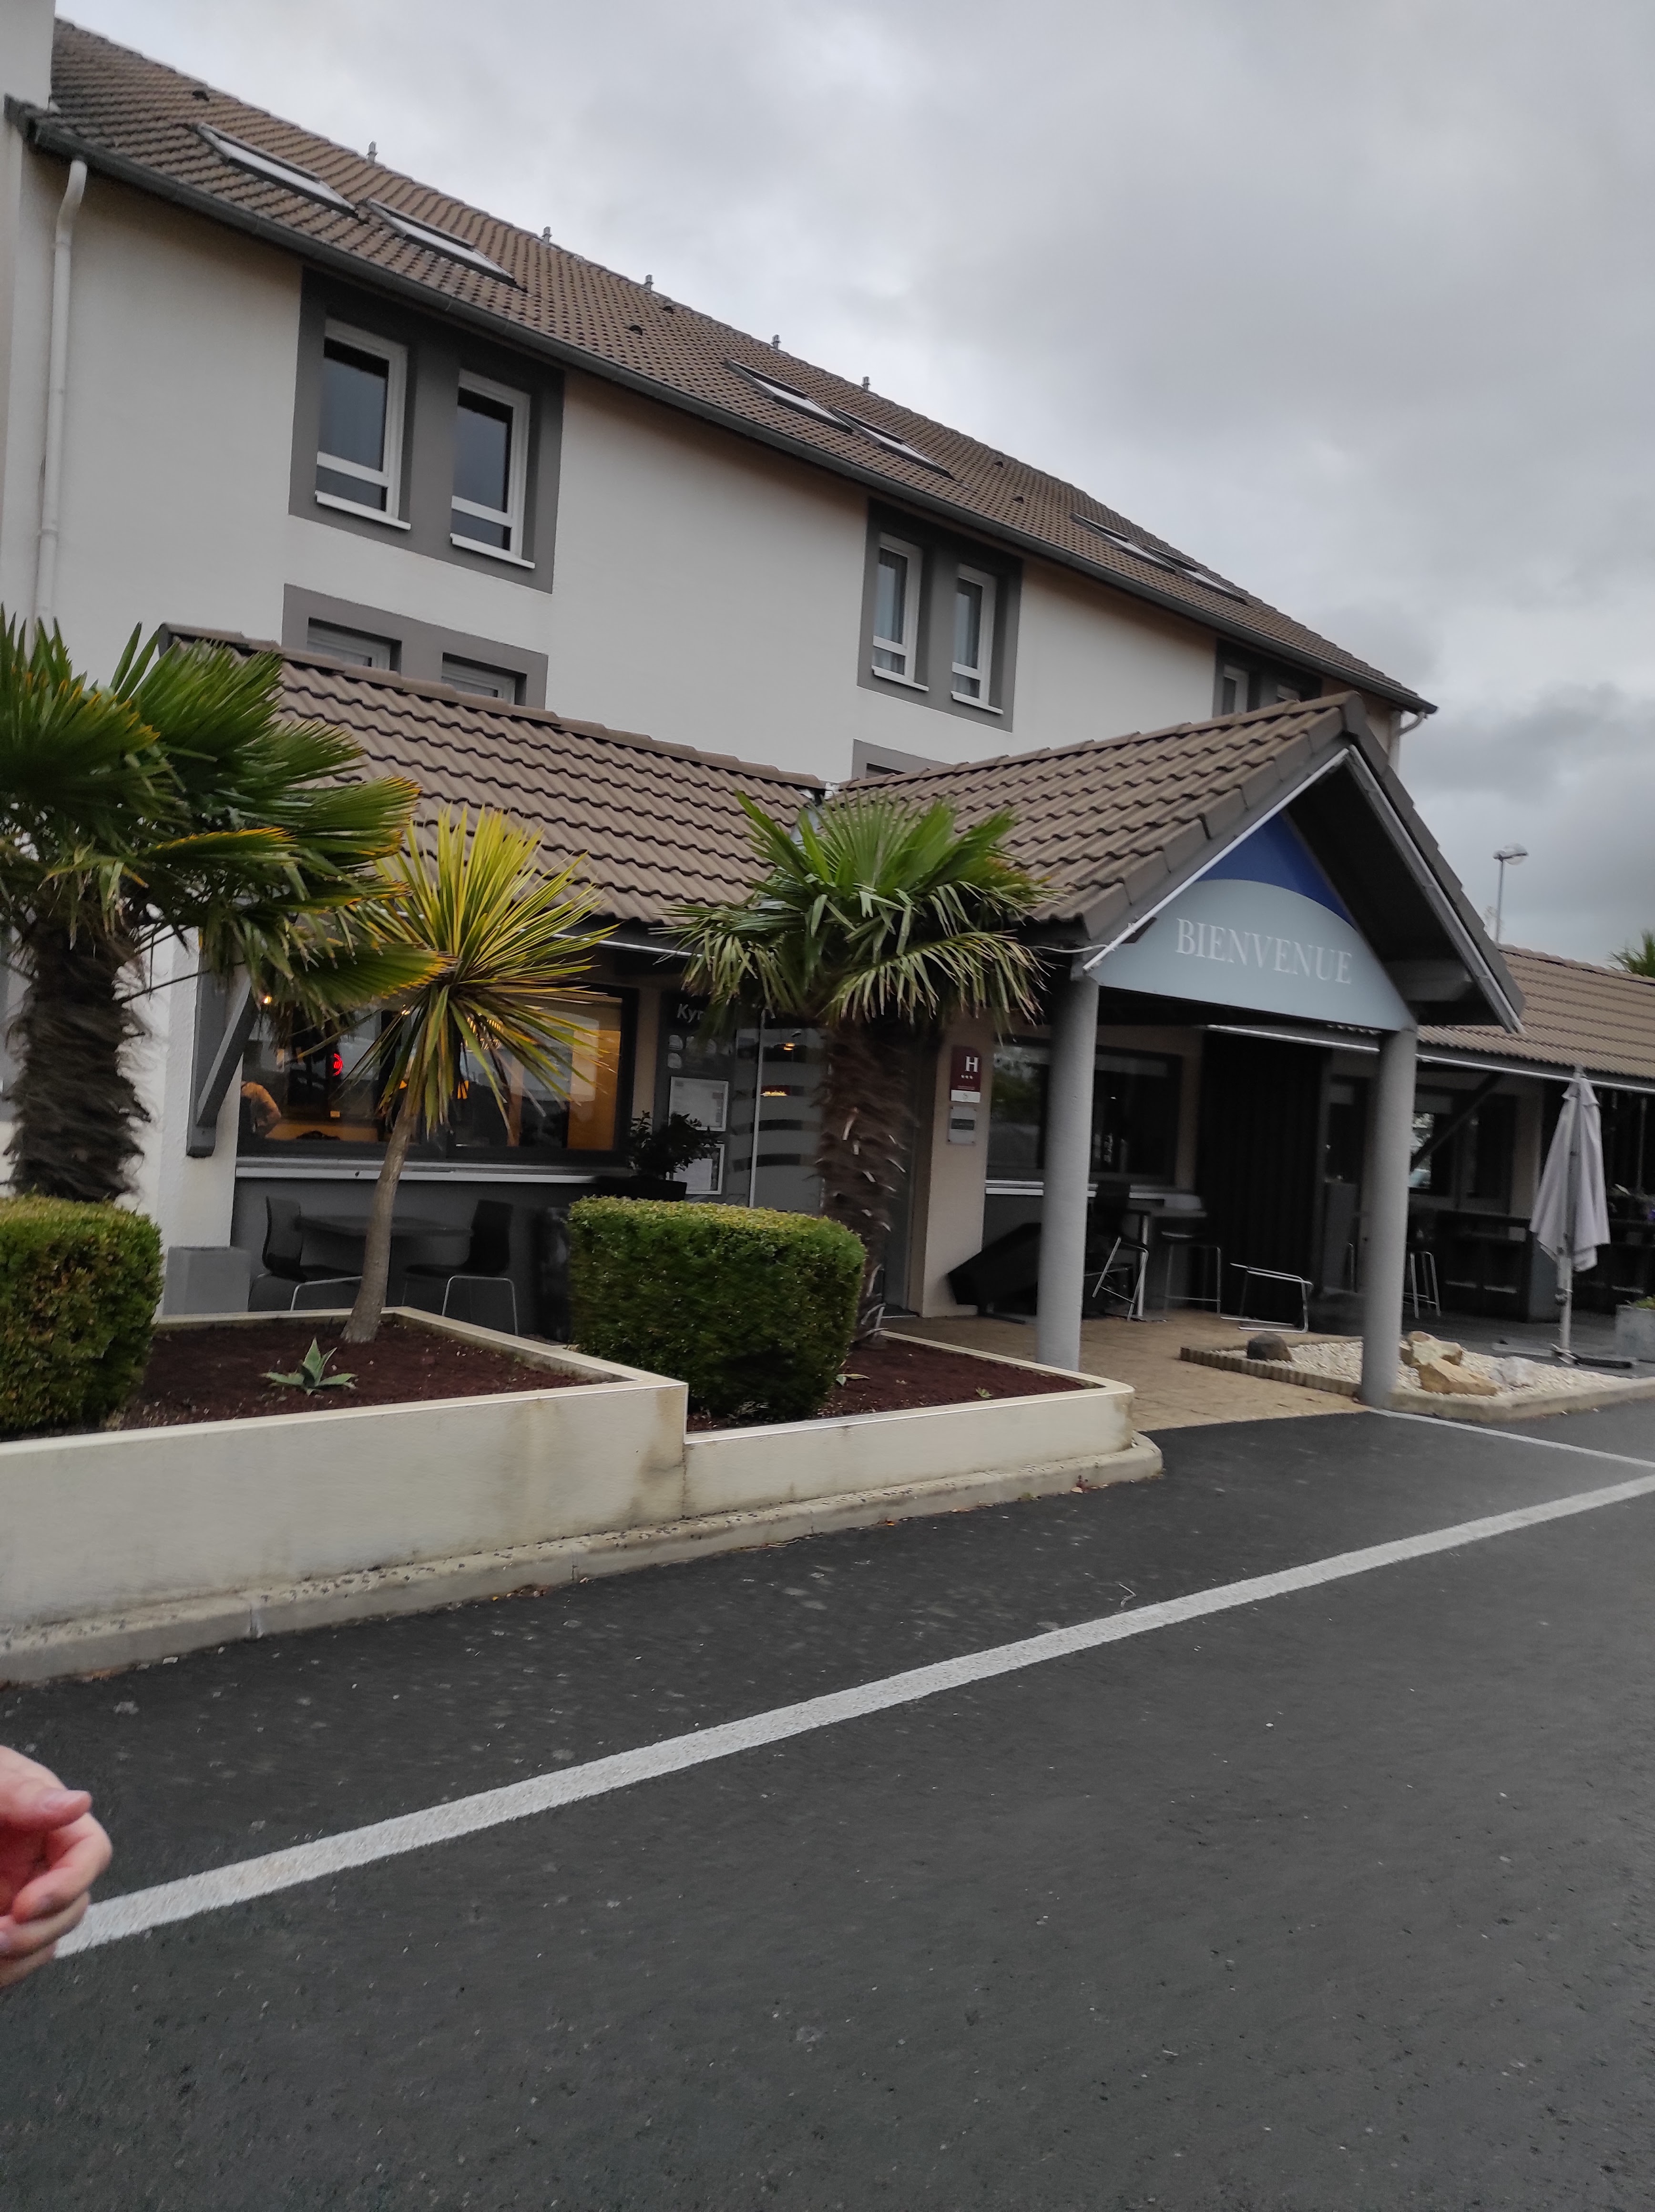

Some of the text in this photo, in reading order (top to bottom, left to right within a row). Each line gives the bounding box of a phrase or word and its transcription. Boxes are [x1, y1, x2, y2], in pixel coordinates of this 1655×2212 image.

[1176, 918, 1352, 984] BIENVENUE
[677, 1004, 704, 1023] Kyr
[965, 1055, 979, 1072] H
